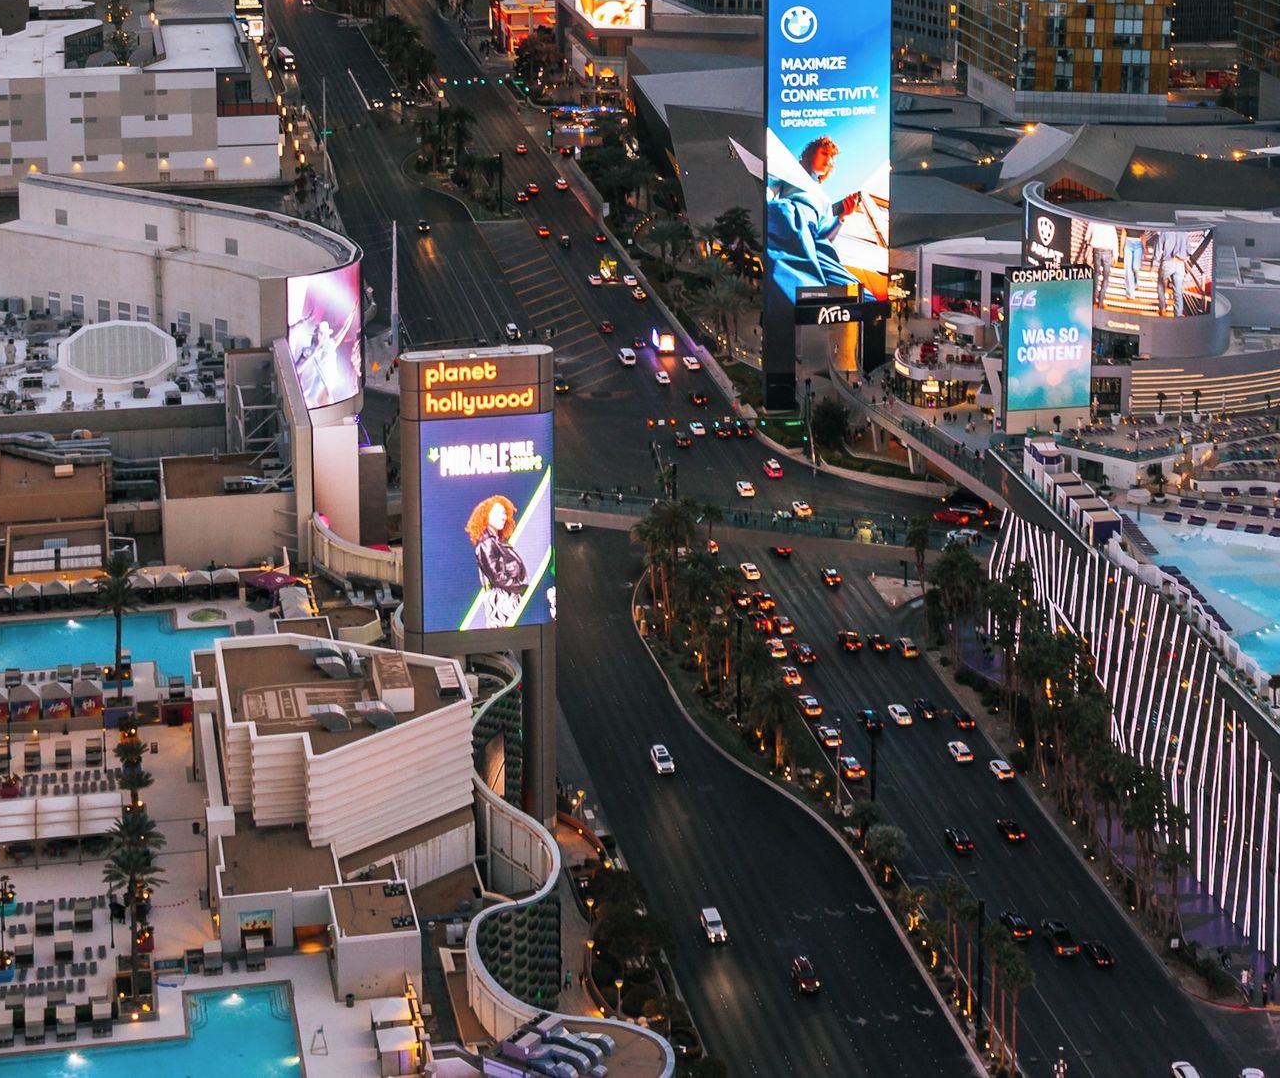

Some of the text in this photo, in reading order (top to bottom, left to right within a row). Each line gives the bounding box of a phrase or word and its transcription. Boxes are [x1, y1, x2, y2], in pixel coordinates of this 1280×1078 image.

[781, 56, 847, 71] MAXIMIZE
[780, 73, 819, 87] YOUR
[780, 85, 880, 103] CONNECTIVITY.
[780, 105, 877, 118] BMW CONNECTED DRIVE
[780, 118, 828, 128] UPGRADES.
[1045, 261, 1061, 270] THE
[1012, 267, 1093, 283] COSMOPOLITAN
[818, 305, 851, 325] Aria
[1022, 326, 1079, 345] WAS SO
[1017, 344, 1084, 363] CONTENT
[425, 361, 497, 390] planet
[425, 387, 534, 416] hollywood
[509, 440, 534, 457] MILE
[439, 442, 510, 478] MIRACLE
[510, 455, 543, 472] SHOPS
